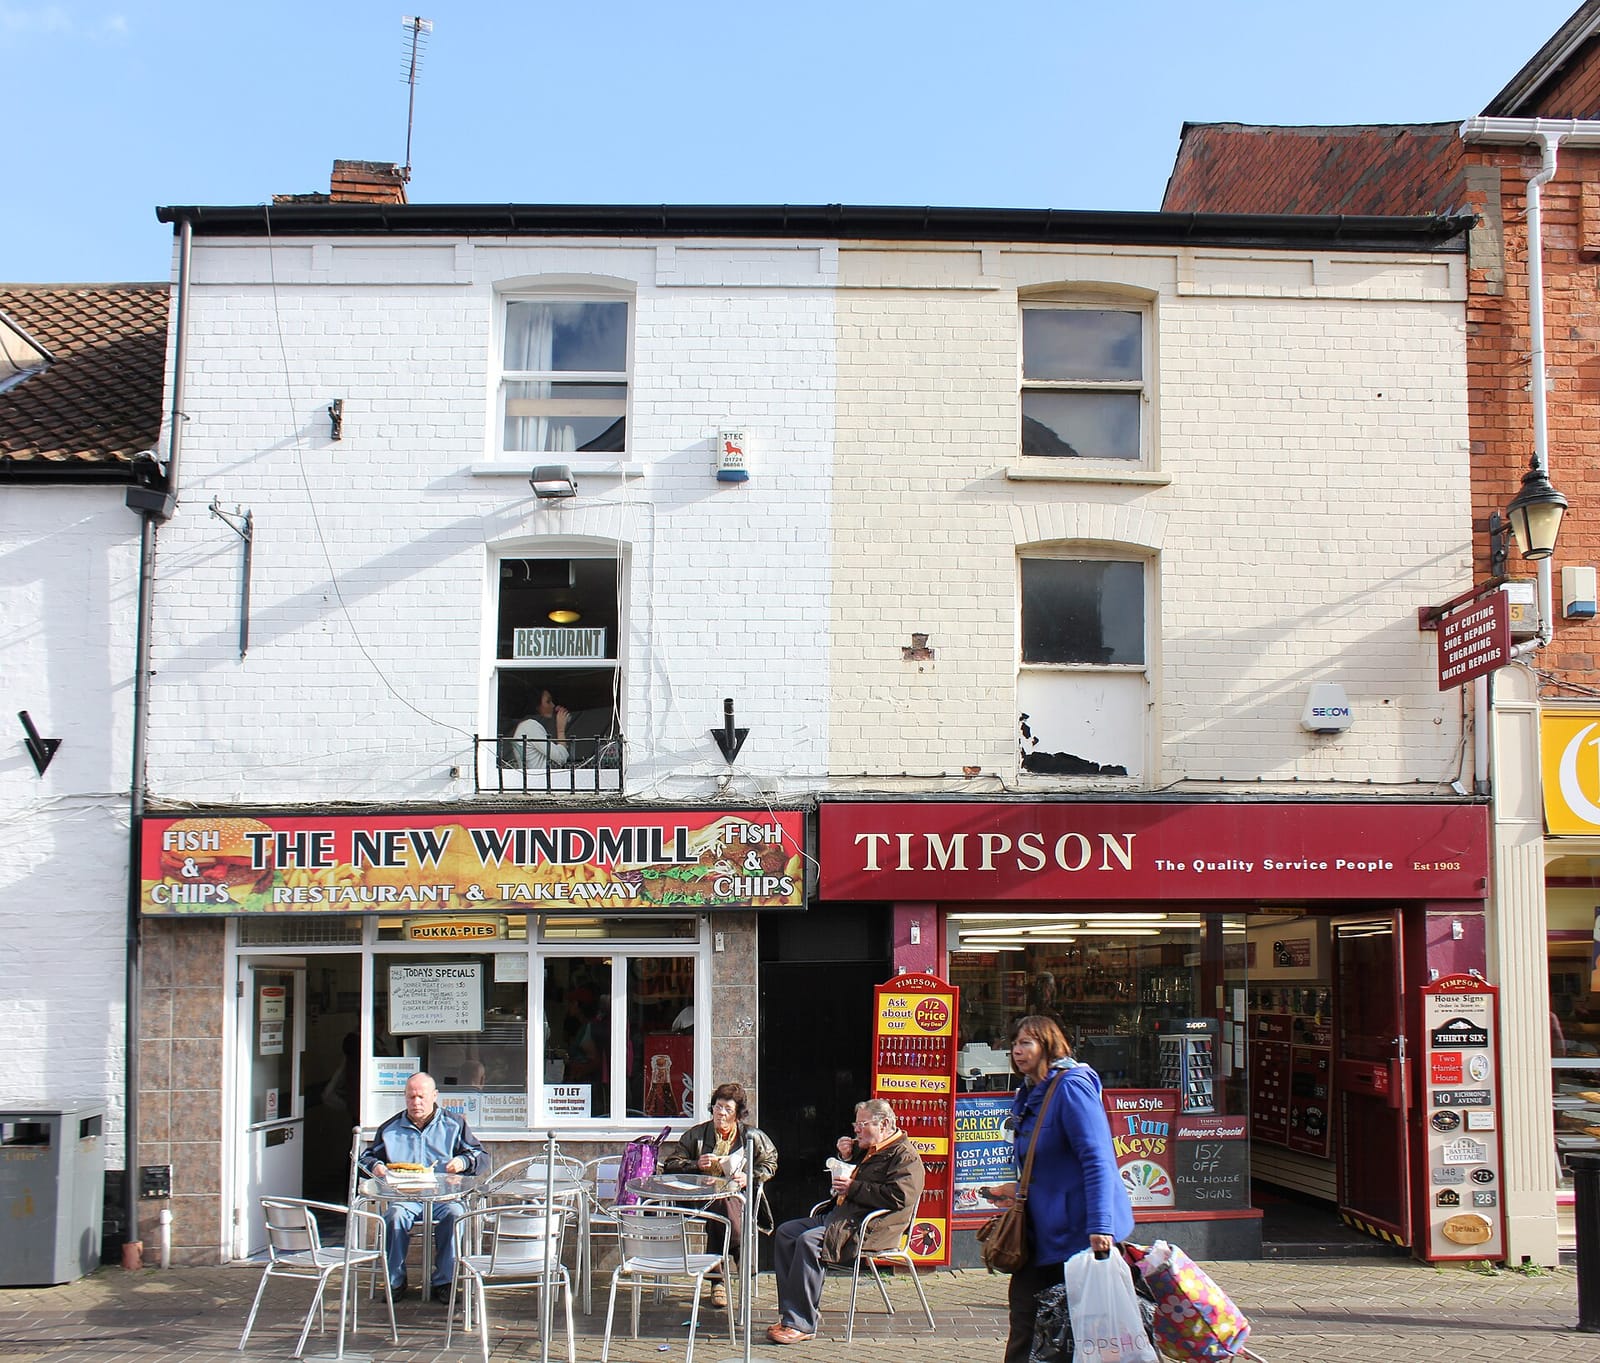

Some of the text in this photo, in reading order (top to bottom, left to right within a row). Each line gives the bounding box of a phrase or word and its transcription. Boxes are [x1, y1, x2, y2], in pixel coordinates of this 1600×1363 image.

[1445, 606, 1494, 637] KEY CUTTING
[1444, 619, 1496, 652] SHOE REPAIRS
[517, 630, 601, 656] RESTAURANT
[1449, 636, 1491, 663] ENGRAVING
[1442, 648, 1501, 680] WATCH REPAIRS
[1312, 708, 1348, 716] SECOM
[725, 824, 782, 844] FISH
[163, 831, 220, 851] FISH
[245, 826, 700, 870] THE NEW WINDMILL
[854, 832, 1136, 872] TIMPSON
[744, 851, 762, 871] &
[1155, 859, 1393, 873] The Quality Service People
[1413, 862, 1460, 871] Est 1903
[181, 857, 199, 877] &
[713, 876, 794, 897] CHIPS
[151, 883, 229, 904] CHIPS
[273, 882, 642, 903] RESTAURANT & TAKEAWAY
[413, 927, 493, 936] PUKKA-PIES
[436, 969, 475, 978] SPECIALS
[896, 978, 937, 989] TIMPSON
[1440, 980, 1479, 989] TIMPSON
[888, 998, 907, 1007] Ask
[1463, 994, 1484, 1002] Signs
[924, 1001, 940, 1010] 1/2
[882, 1009, 912, 1018] about
[917, 1011, 946, 1021] Price
[882, 1078, 946, 1090] House Keys
[553, 1088, 581, 1096] TO LET
[484, 1096, 525, 1104] Tables & Chairs
[1116, 1098, 1163, 1111] New Style
[1439, 1094, 1450, 1104] 10
[955, 1117, 1000, 1130] CAR KEY
[1124, 1114, 1169, 1137] Fun
[956, 1132, 999, 1140] SPECIALISTS
[1178, 1127, 1215, 1138] Managers
[1216, 1127, 1244, 1138] Special
[910, 1141, 936, 1152] Keys
[1112, 1134, 1167, 1158] Keys
[956, 1149, 981, 1159] LOST
[983, 1148, 990, 1157] A
[1195, 1144, 1224, 1160] 15%
[1193, 1161, 1219, 1172] OFF
[1177, 1174, 1240, 1184] ALL HOUSE
[1477, 1172, 1489, 1180] 73
[1195, 1187, 1232, 1199] SIGNS
[1443, 1194, 1456, 1203] 49
[1478, 1194, 1492, 1204] 28
[1076, 1333, 1148, 1356] OPSHO
